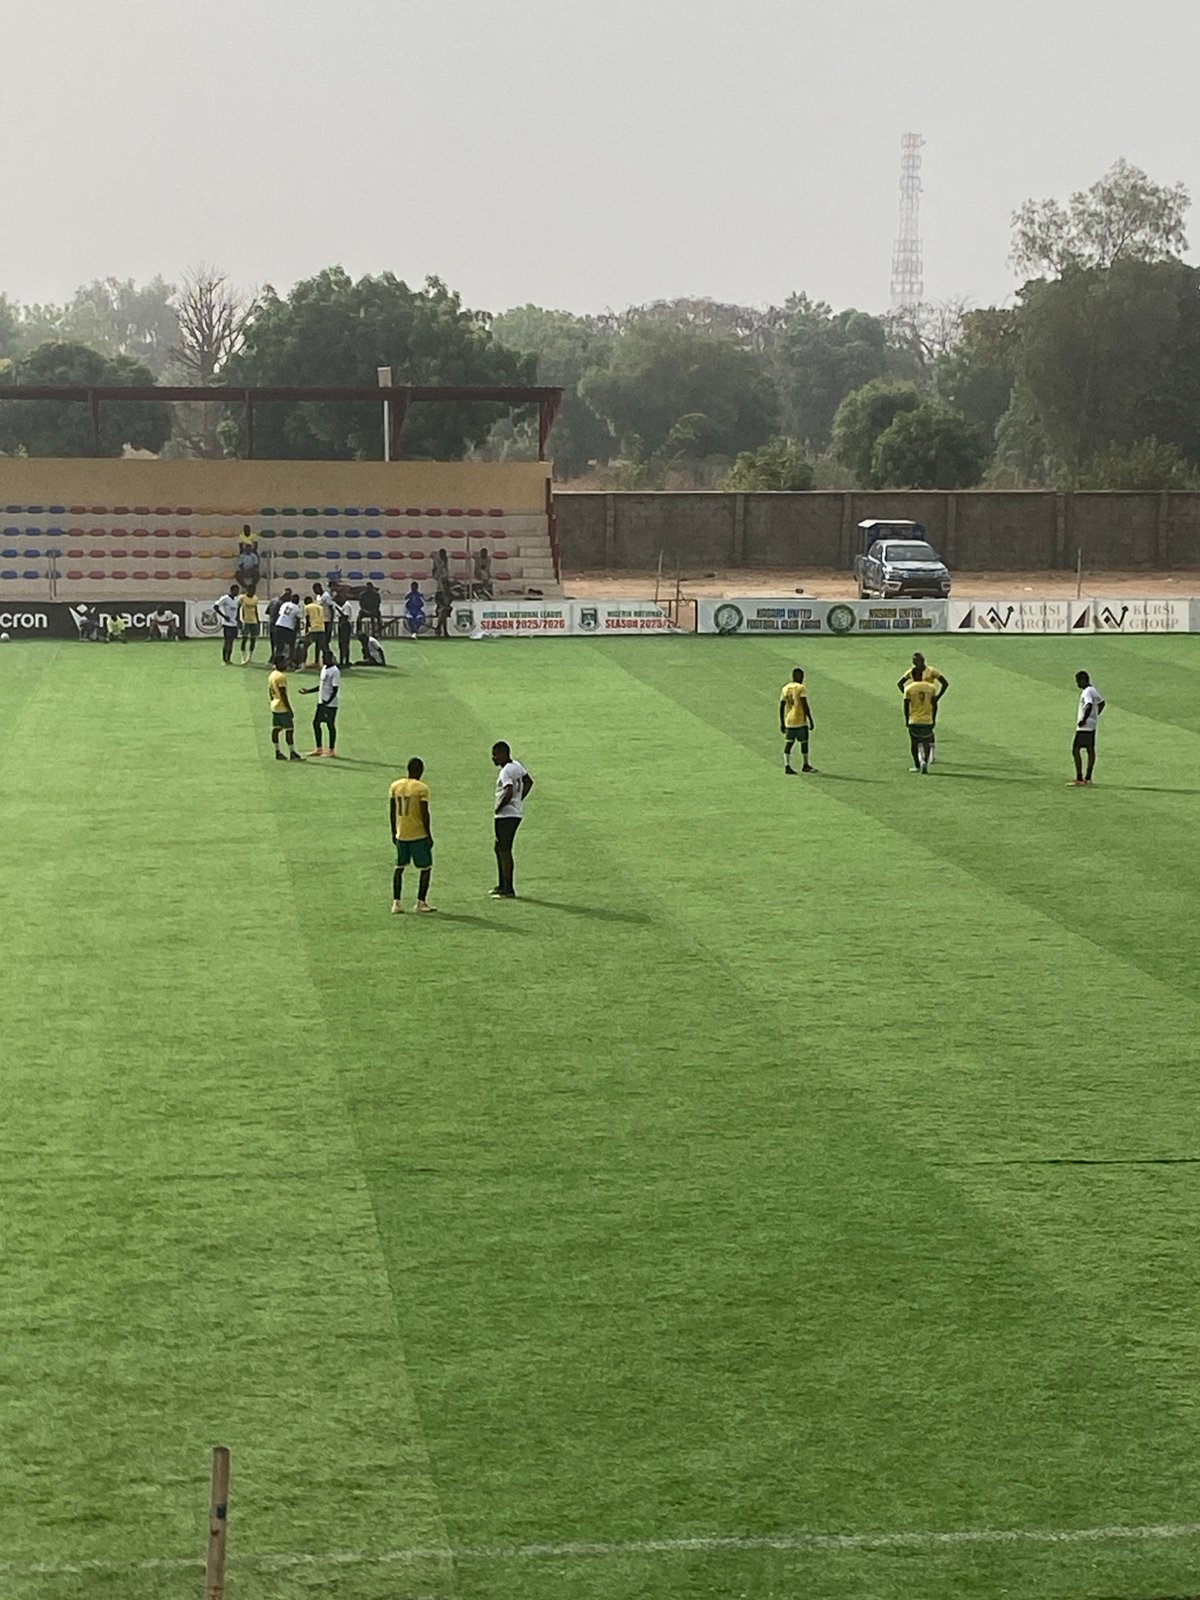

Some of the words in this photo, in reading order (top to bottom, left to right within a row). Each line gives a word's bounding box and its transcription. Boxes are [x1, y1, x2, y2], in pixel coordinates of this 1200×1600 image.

[480, 620, 514, 630] SEASON
[515, 620, 566, 629] 2025/2026
[605, 619, 639, 629] SEASON
[1129, 619, 1179, 630] GROUP
[397, 796, 411, 817] 17
